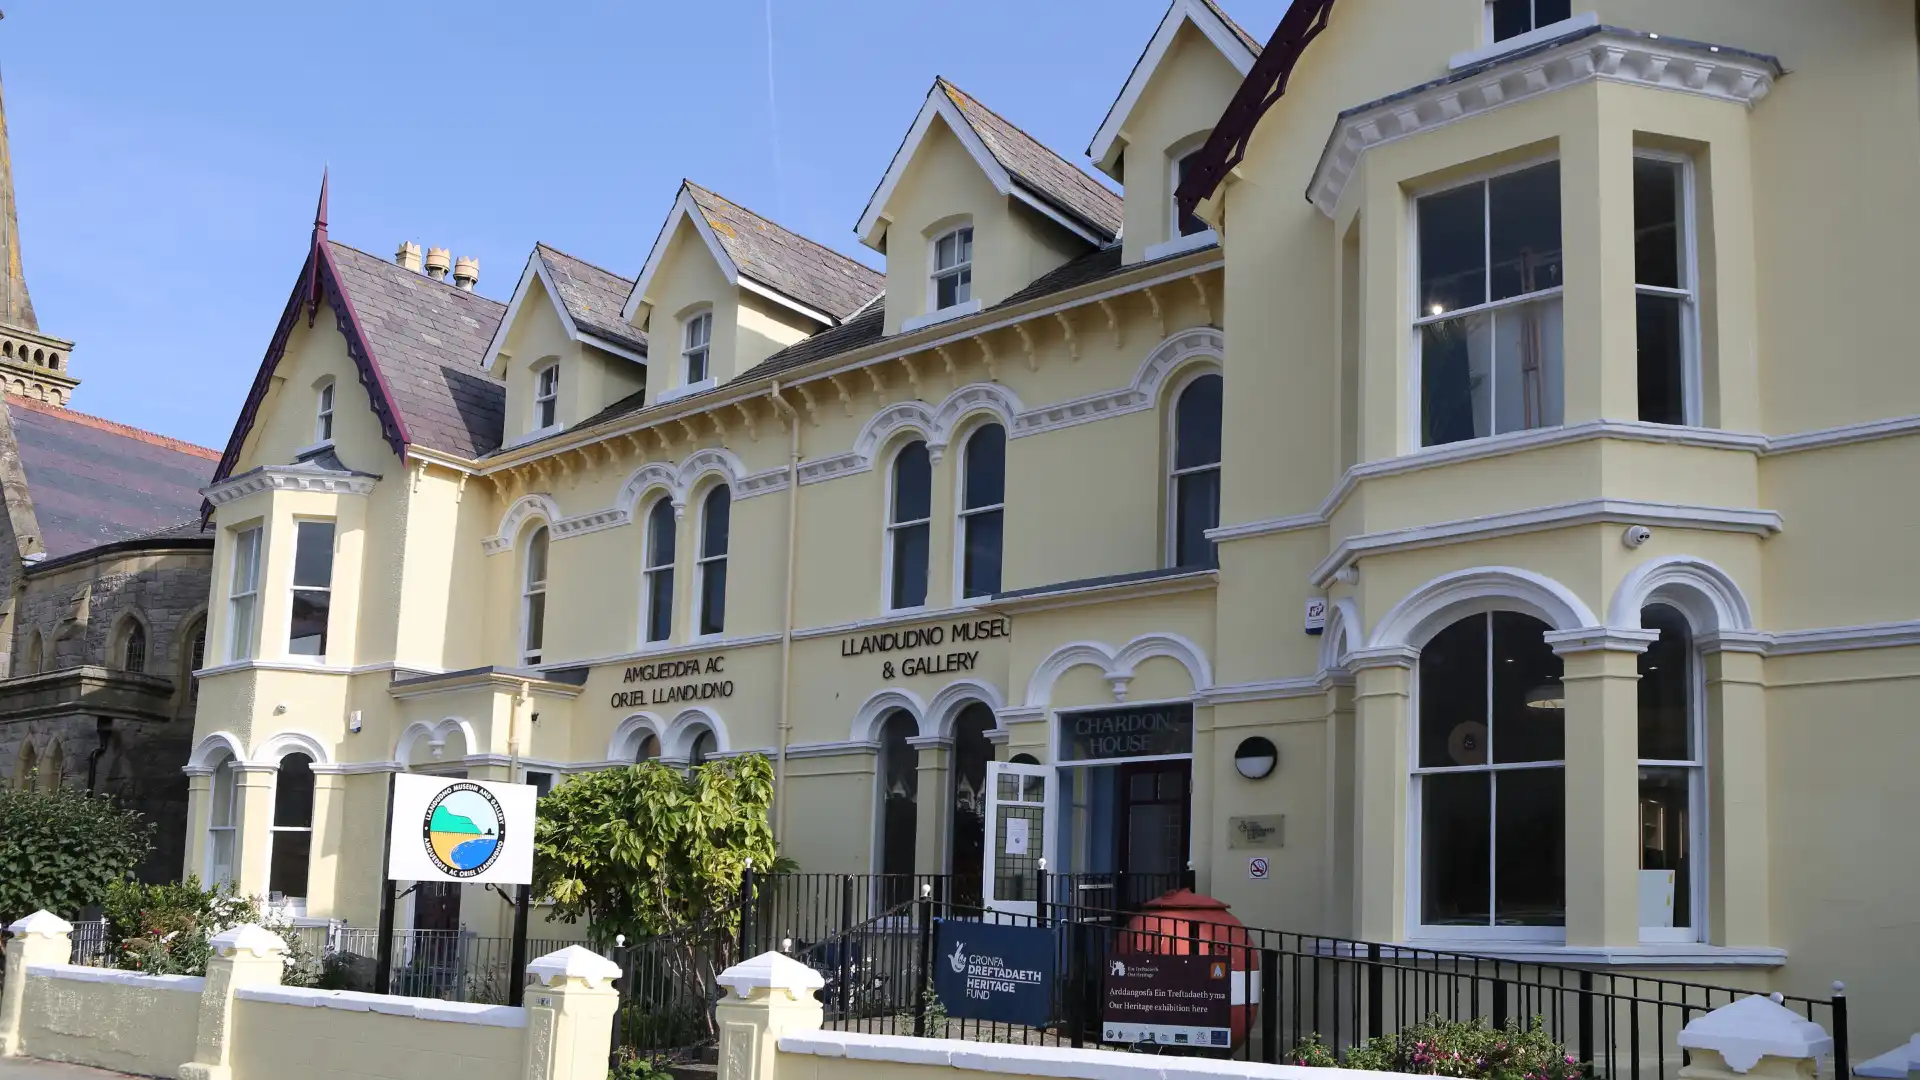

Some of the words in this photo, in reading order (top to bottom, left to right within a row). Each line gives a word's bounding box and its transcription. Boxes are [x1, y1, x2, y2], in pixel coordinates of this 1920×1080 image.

[841, 626, 943, 657] LLANDUDNO
[951, 618, 1009, 642] MUSEU
[623, 659, 700, 683] AMGUEDDFA
[705, 656, 724, 674] AC
[882, 661, 895, 679] &
[902, 651, 979, 677] GALLERY
[611, 690, 647, 708] ORIEL
[652, 680, 734, 704] LLANDUDNO
[1075, 712, 1170, 735] CHARDON
[1090, 734, 1151, 756] HOUSE
[425, 787, 452, 820] LLANDUDNO
[453, 783, 479, 791] MUSEUM
[480, 788, 491, 800] AND
[491, 799, 504, 825] GALLERY
[424, 837, 448, 872] AMGUEDDFA
[477, 840, 503, 873] LLANDUDNO
[969, 954, 1004, 967] CRONFA
[967, 964, 1042, 981] DREFTADAETH
[966, 978, 1015, 993] HERITAGE
[966, 988, 990, 1000] FUND
[1109, 988, 1153, 998] Arddangosfa
[1154, 988, 1166, 997] Ein
[1167, 989, 1208, 999] Treftadaeth
[1209, 993, 1226, 1001] yma
[1108, 1001, 1123, 1010] Our
[1124, 1002, 1153, 1013] Heritage
[1154, 1003, 1190, 1012] exhibition
[1192, 1004, 1208, 1013] here
